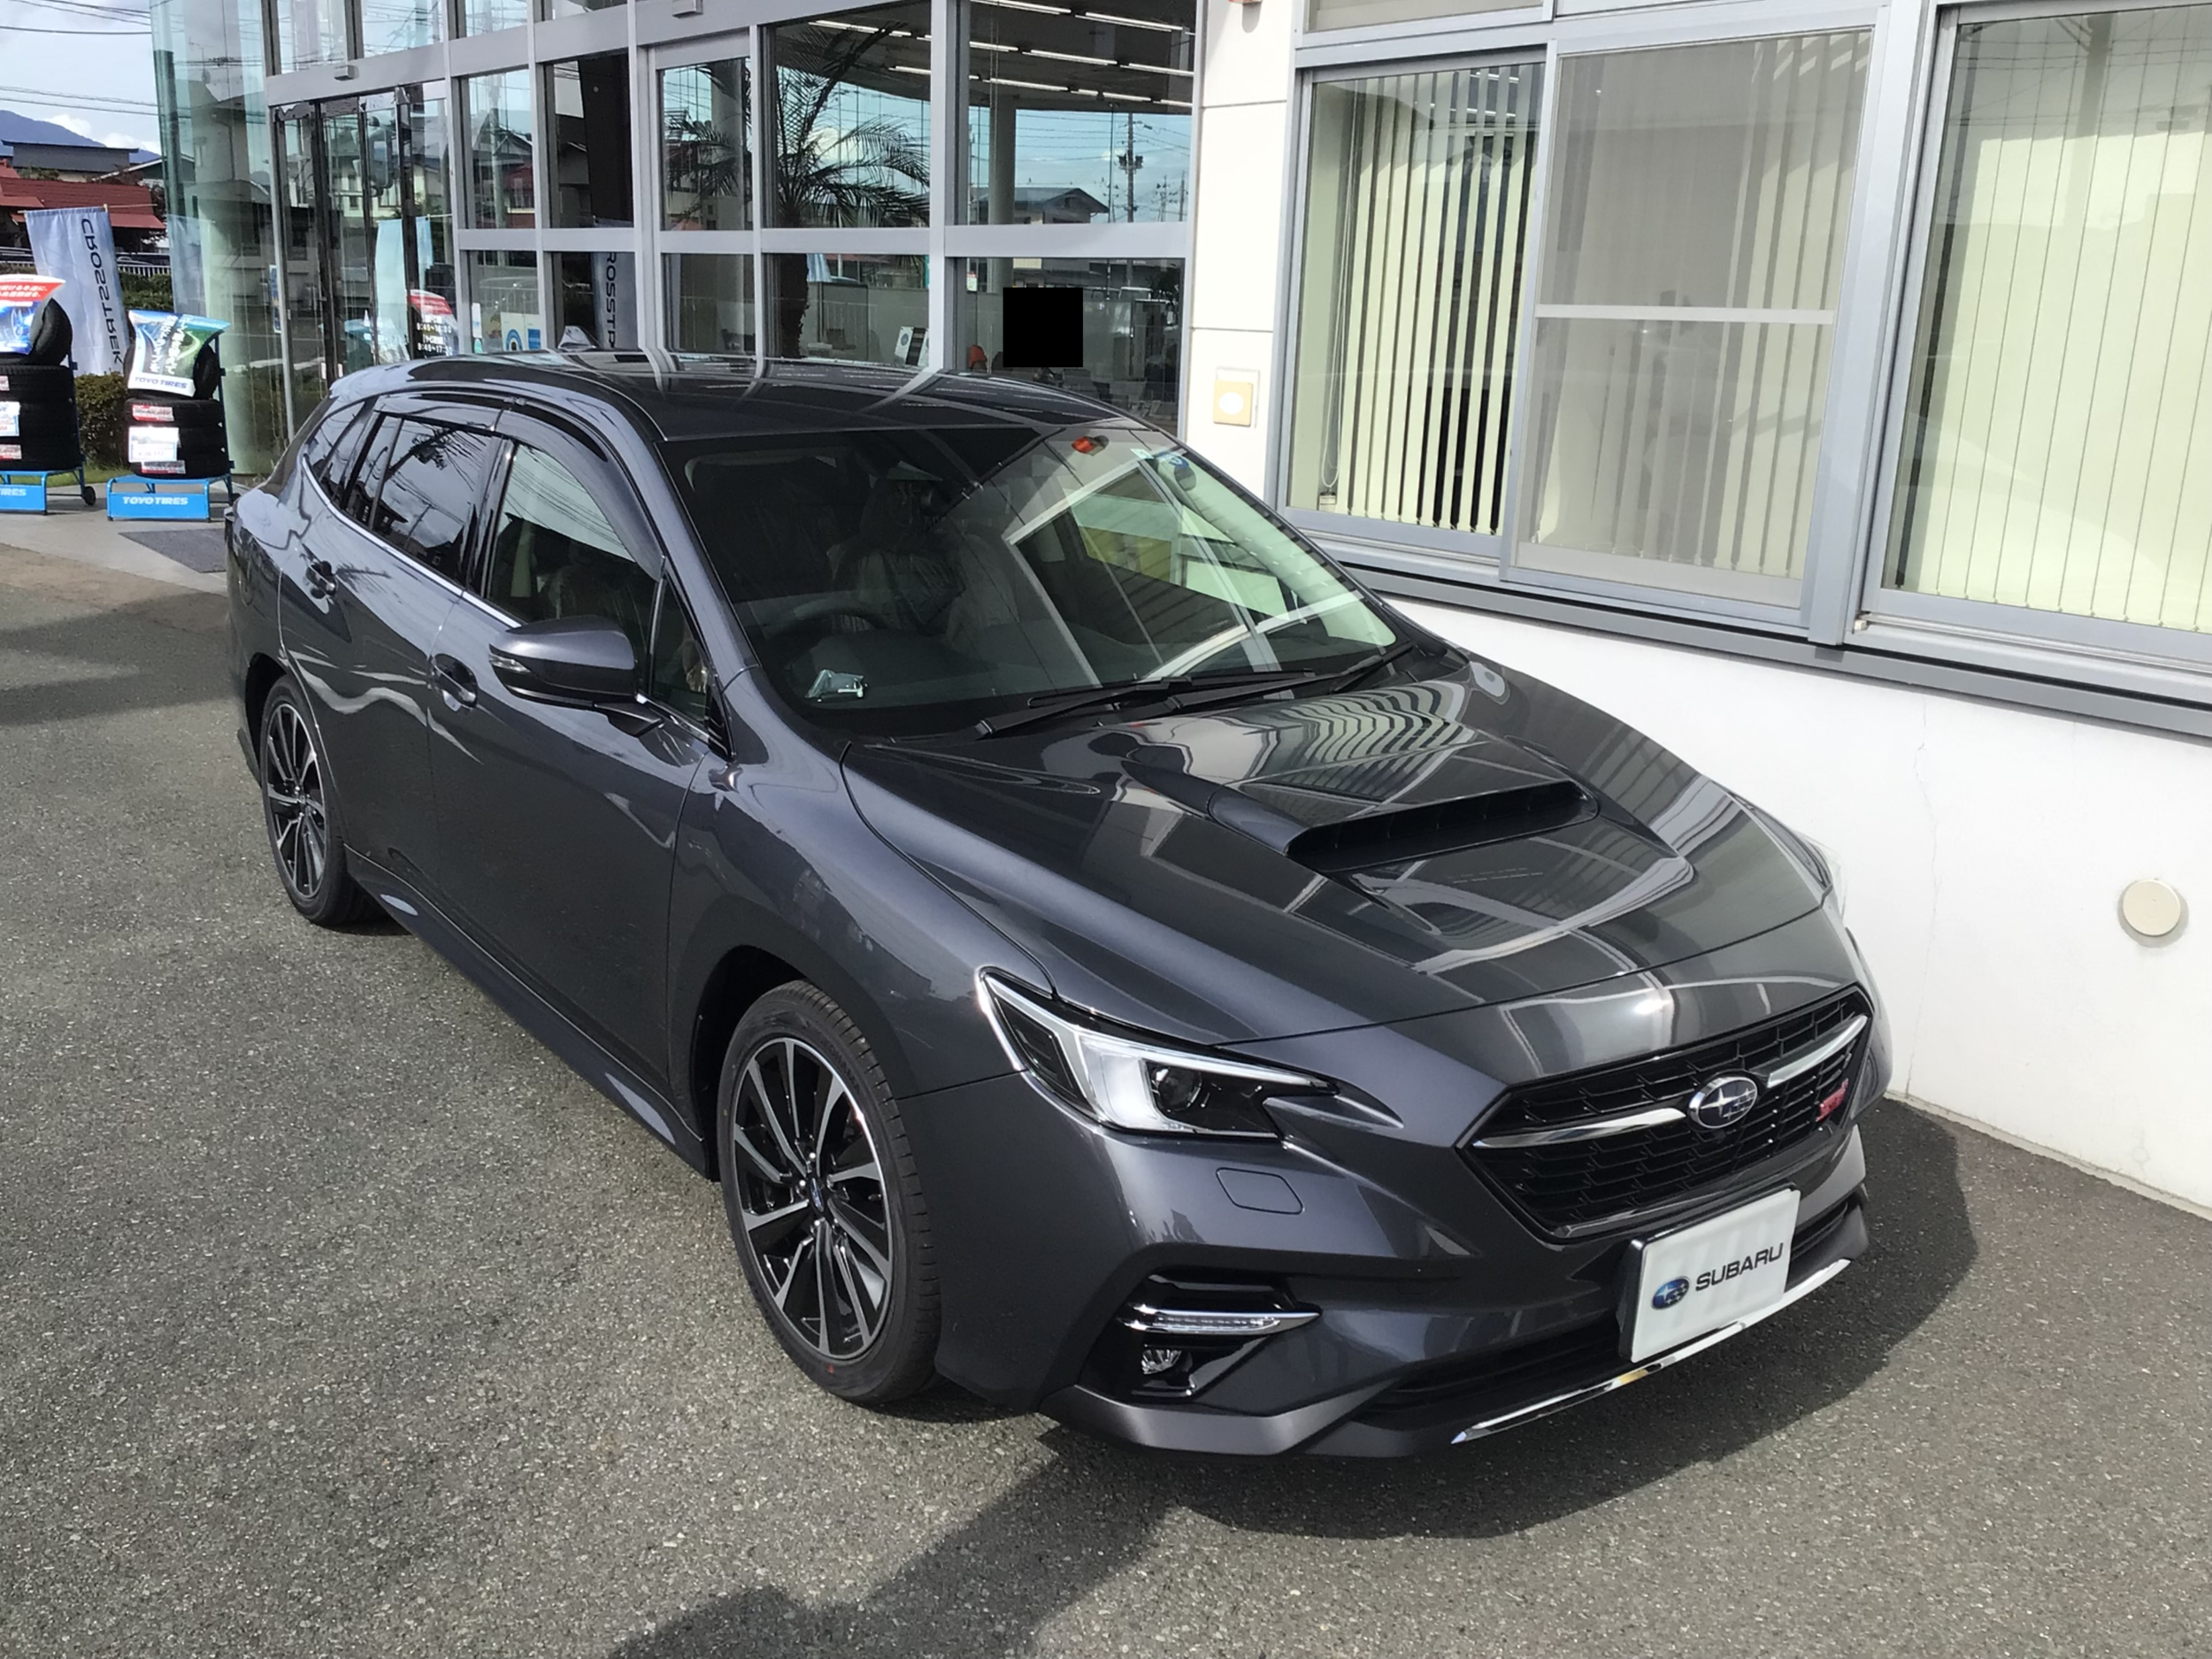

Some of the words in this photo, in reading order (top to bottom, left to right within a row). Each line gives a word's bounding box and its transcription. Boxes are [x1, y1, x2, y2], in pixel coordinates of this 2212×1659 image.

[160, 380, 188, 388] TIRES
[0, 488, 27, 496] IRES
[155, 496, 188, 505] TIRES
[1695, 1242, 1784, 1292] SUBARU
